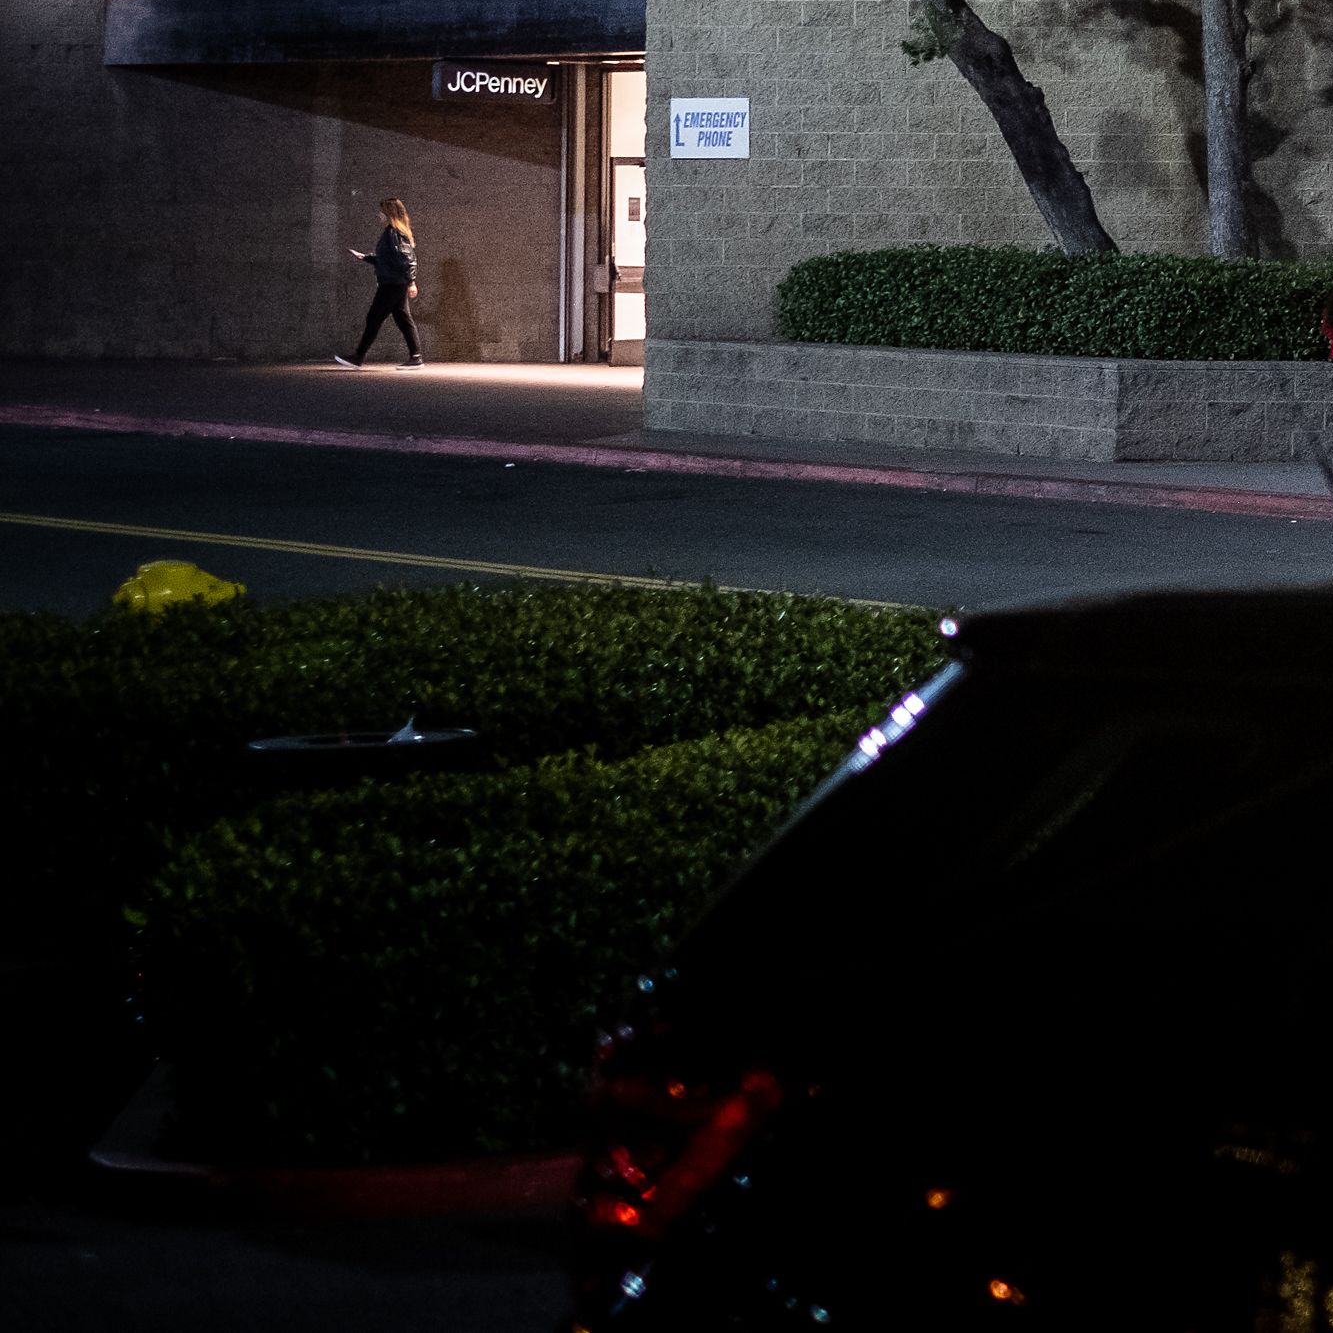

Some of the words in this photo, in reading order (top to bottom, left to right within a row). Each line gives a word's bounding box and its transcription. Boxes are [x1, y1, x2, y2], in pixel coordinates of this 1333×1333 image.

[447, 70, 548, 99] JCPenney
[683, 111, 747, 128] EMERGENCY
[697, 131, 733, 147] PHONE
